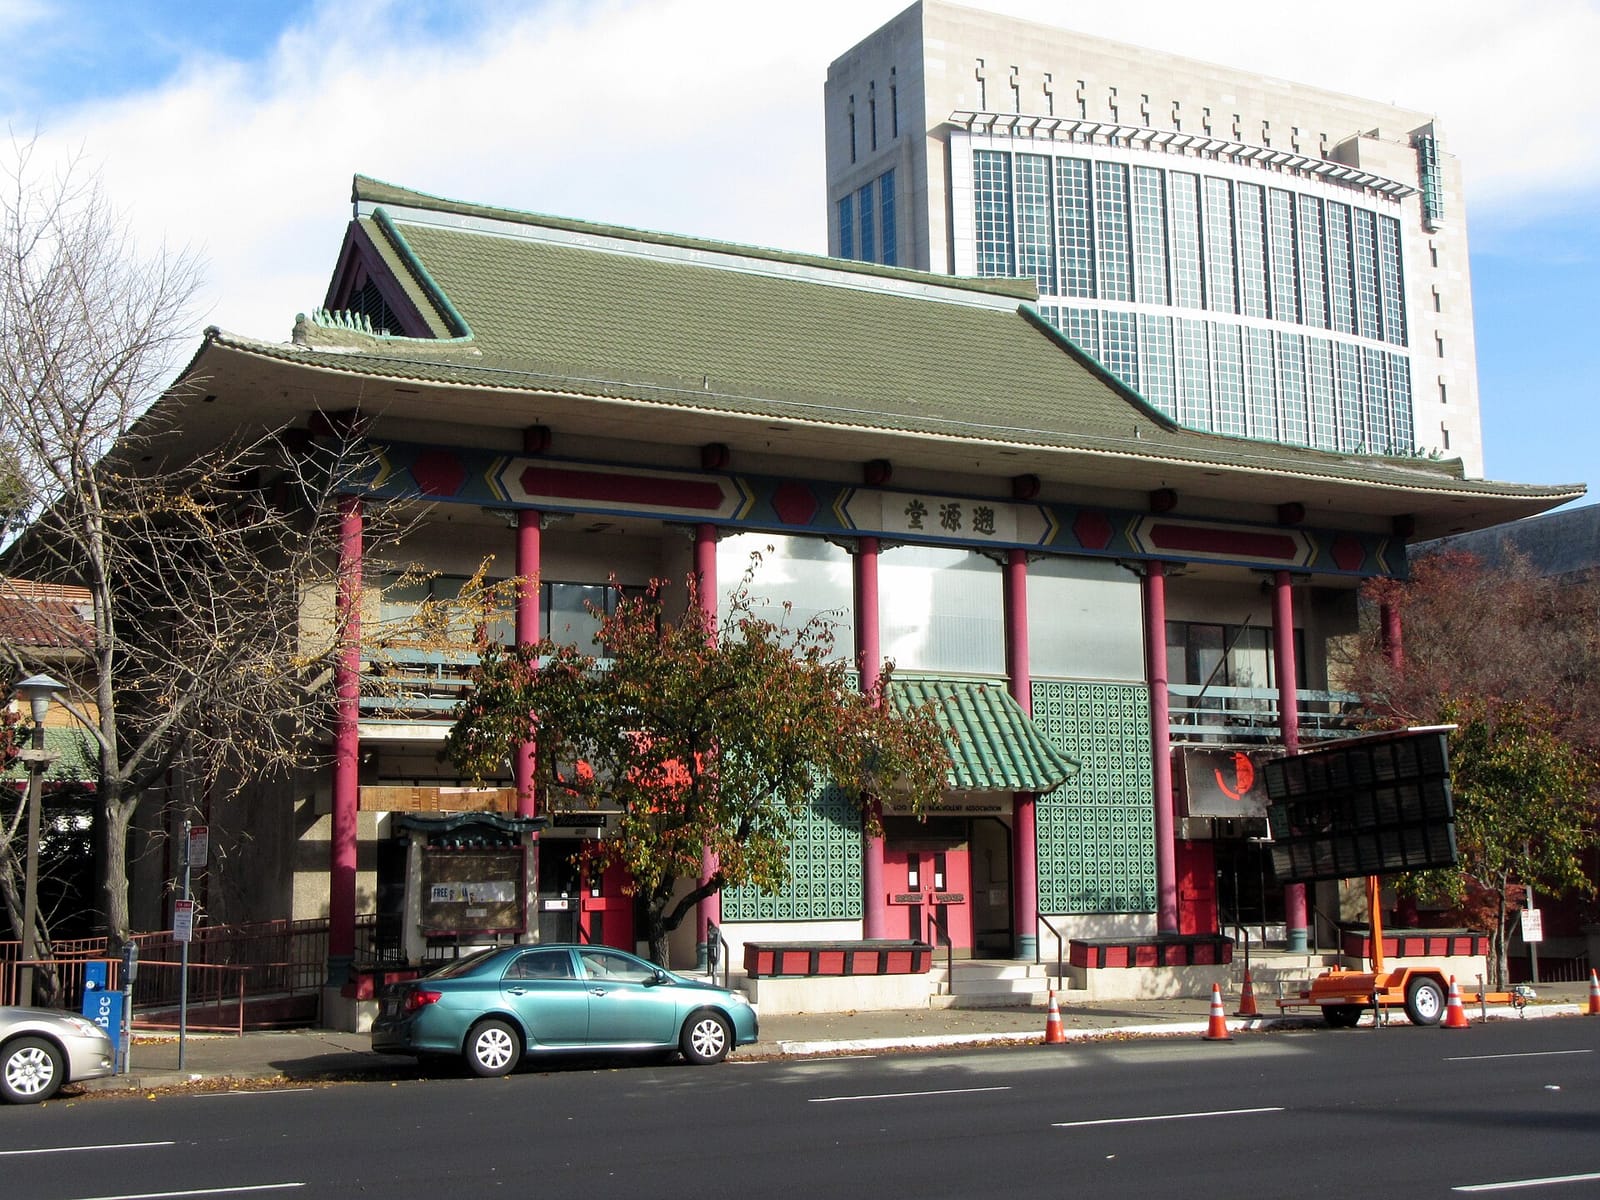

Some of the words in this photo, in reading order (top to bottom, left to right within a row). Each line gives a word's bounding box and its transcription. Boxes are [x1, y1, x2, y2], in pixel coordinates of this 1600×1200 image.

[965, 804, 1002, 812] ASSOCIATION
[433, 887, 448, 898] FREE
[94, 996, 111, 1028] Bee
